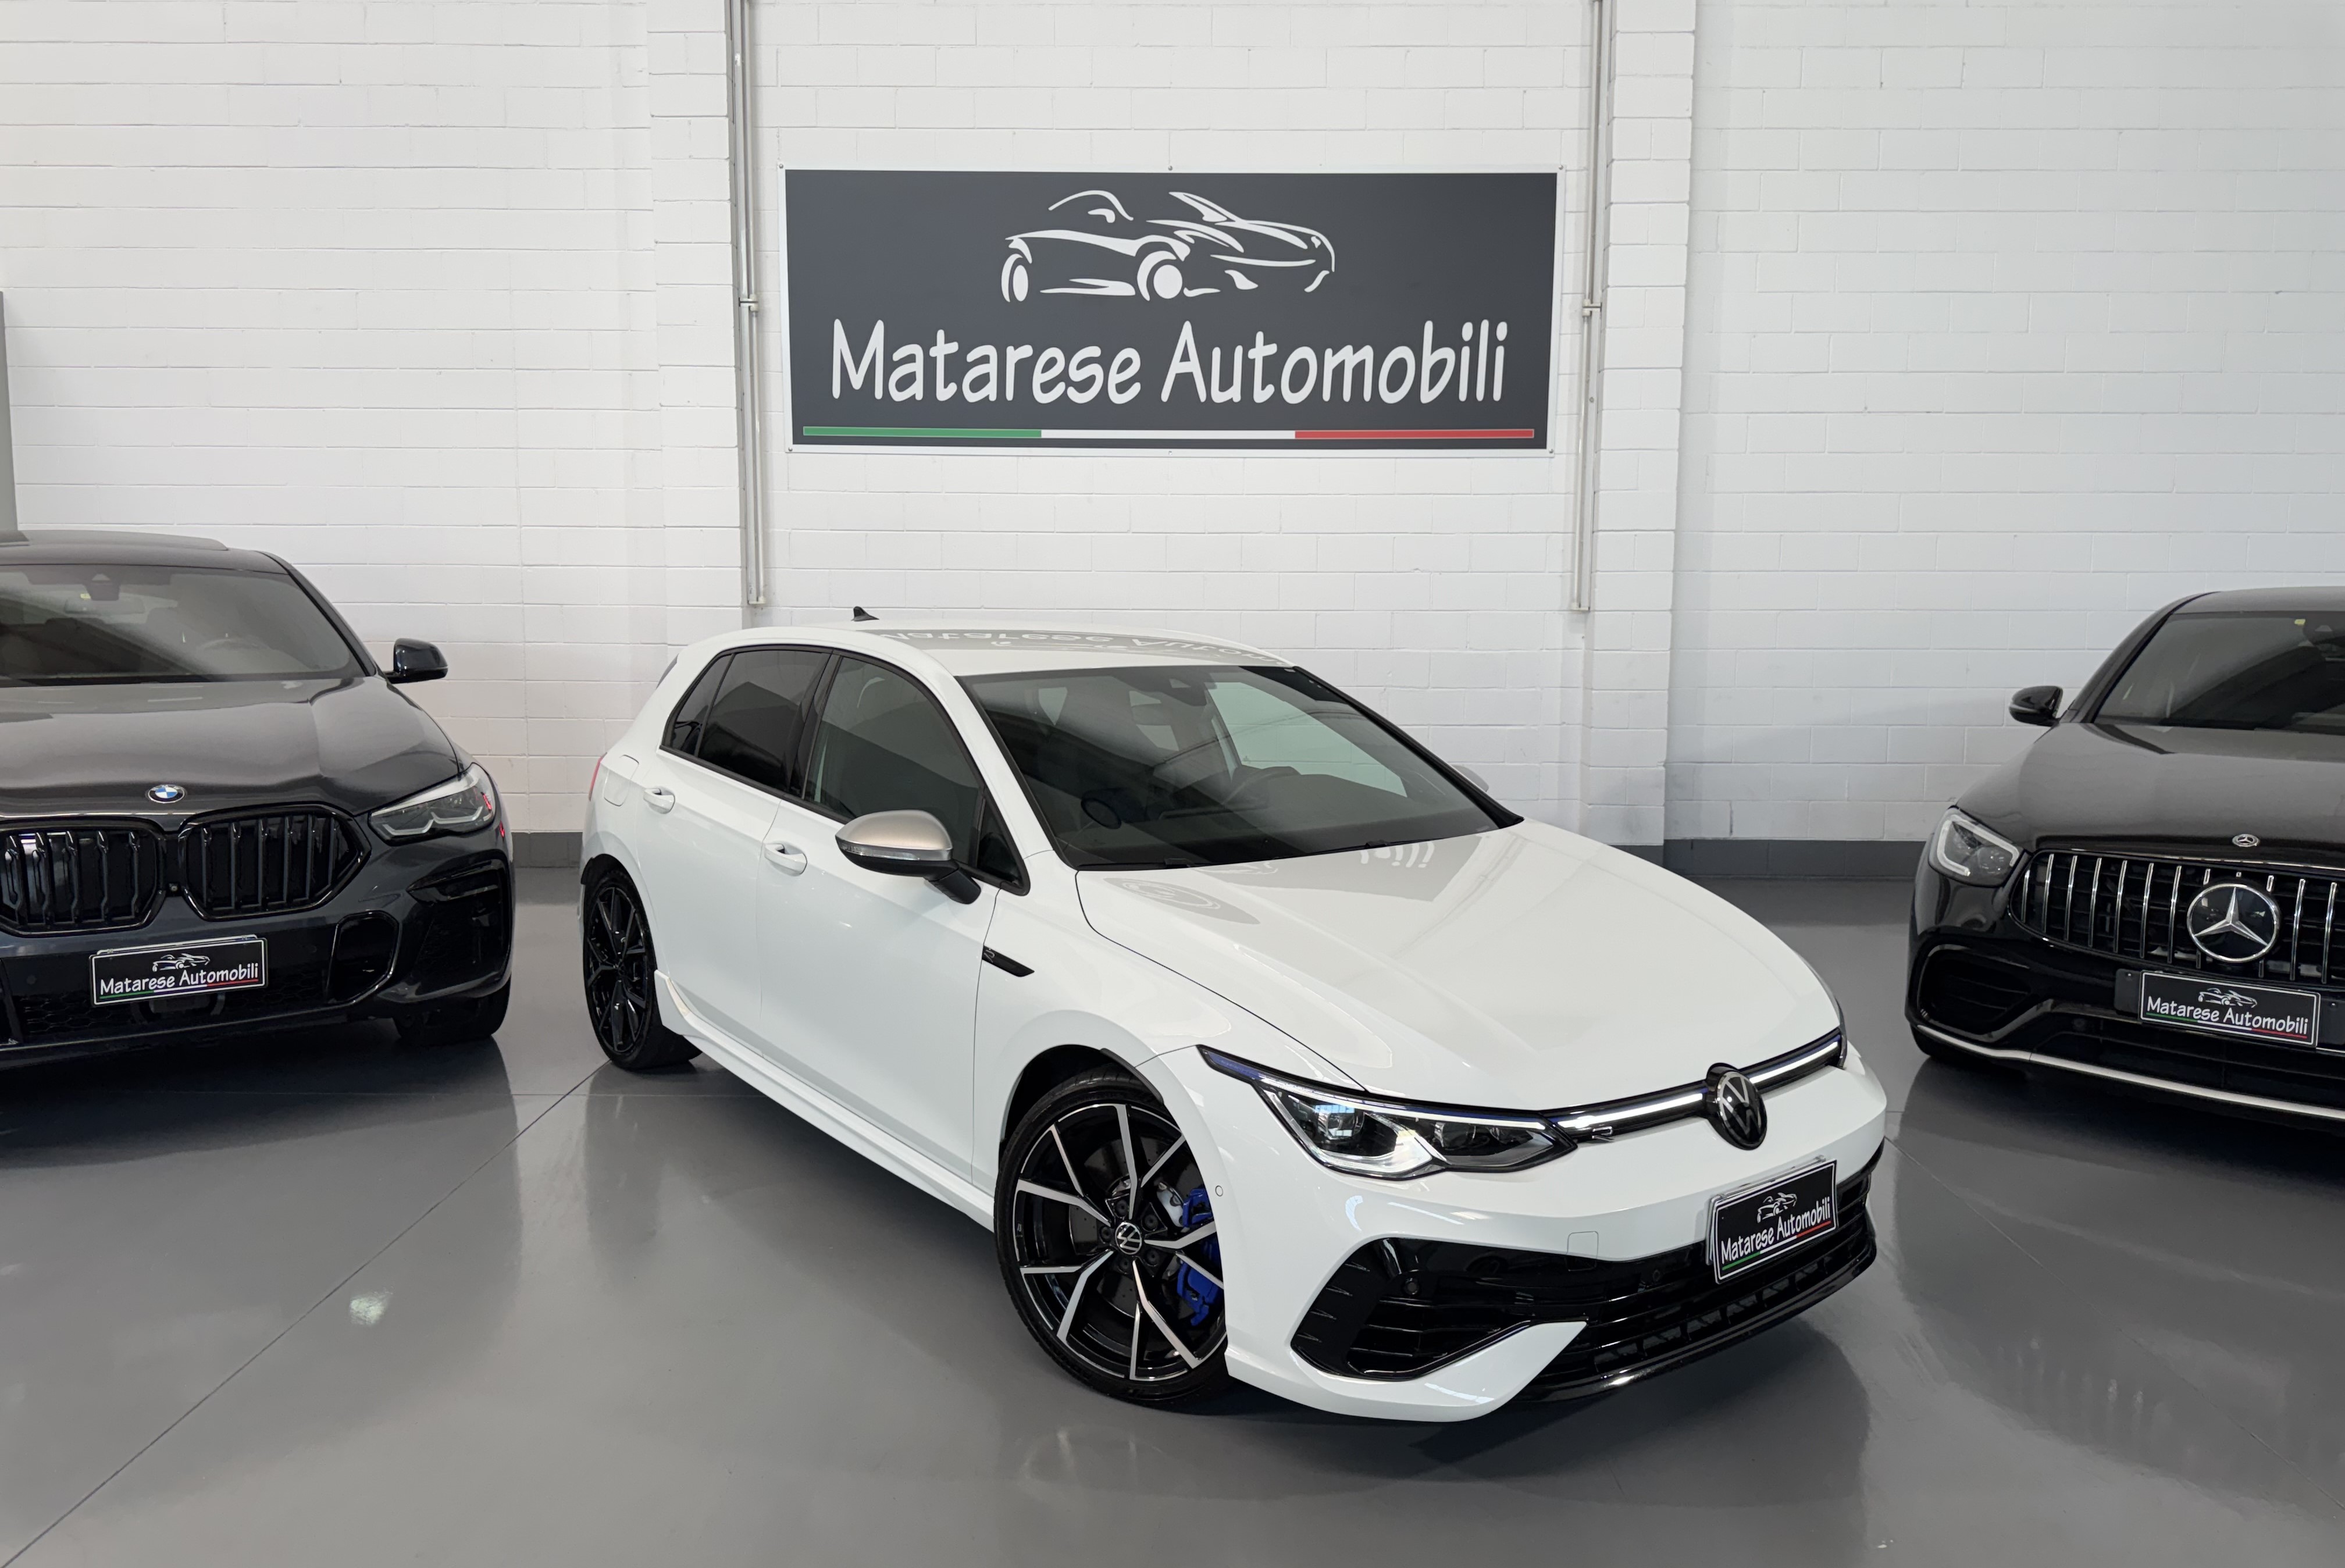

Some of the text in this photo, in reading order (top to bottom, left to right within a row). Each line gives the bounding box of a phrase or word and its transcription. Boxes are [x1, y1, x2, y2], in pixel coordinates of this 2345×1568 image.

[832, 318, 1508, 404] Matarese Automobili
[100, 963, 258, 995] Matarese Automobili
[2147, 996, 2308, 1035] Matarese Automobili
[1721, 1196, 1830, 1264] Matarese Automobili
